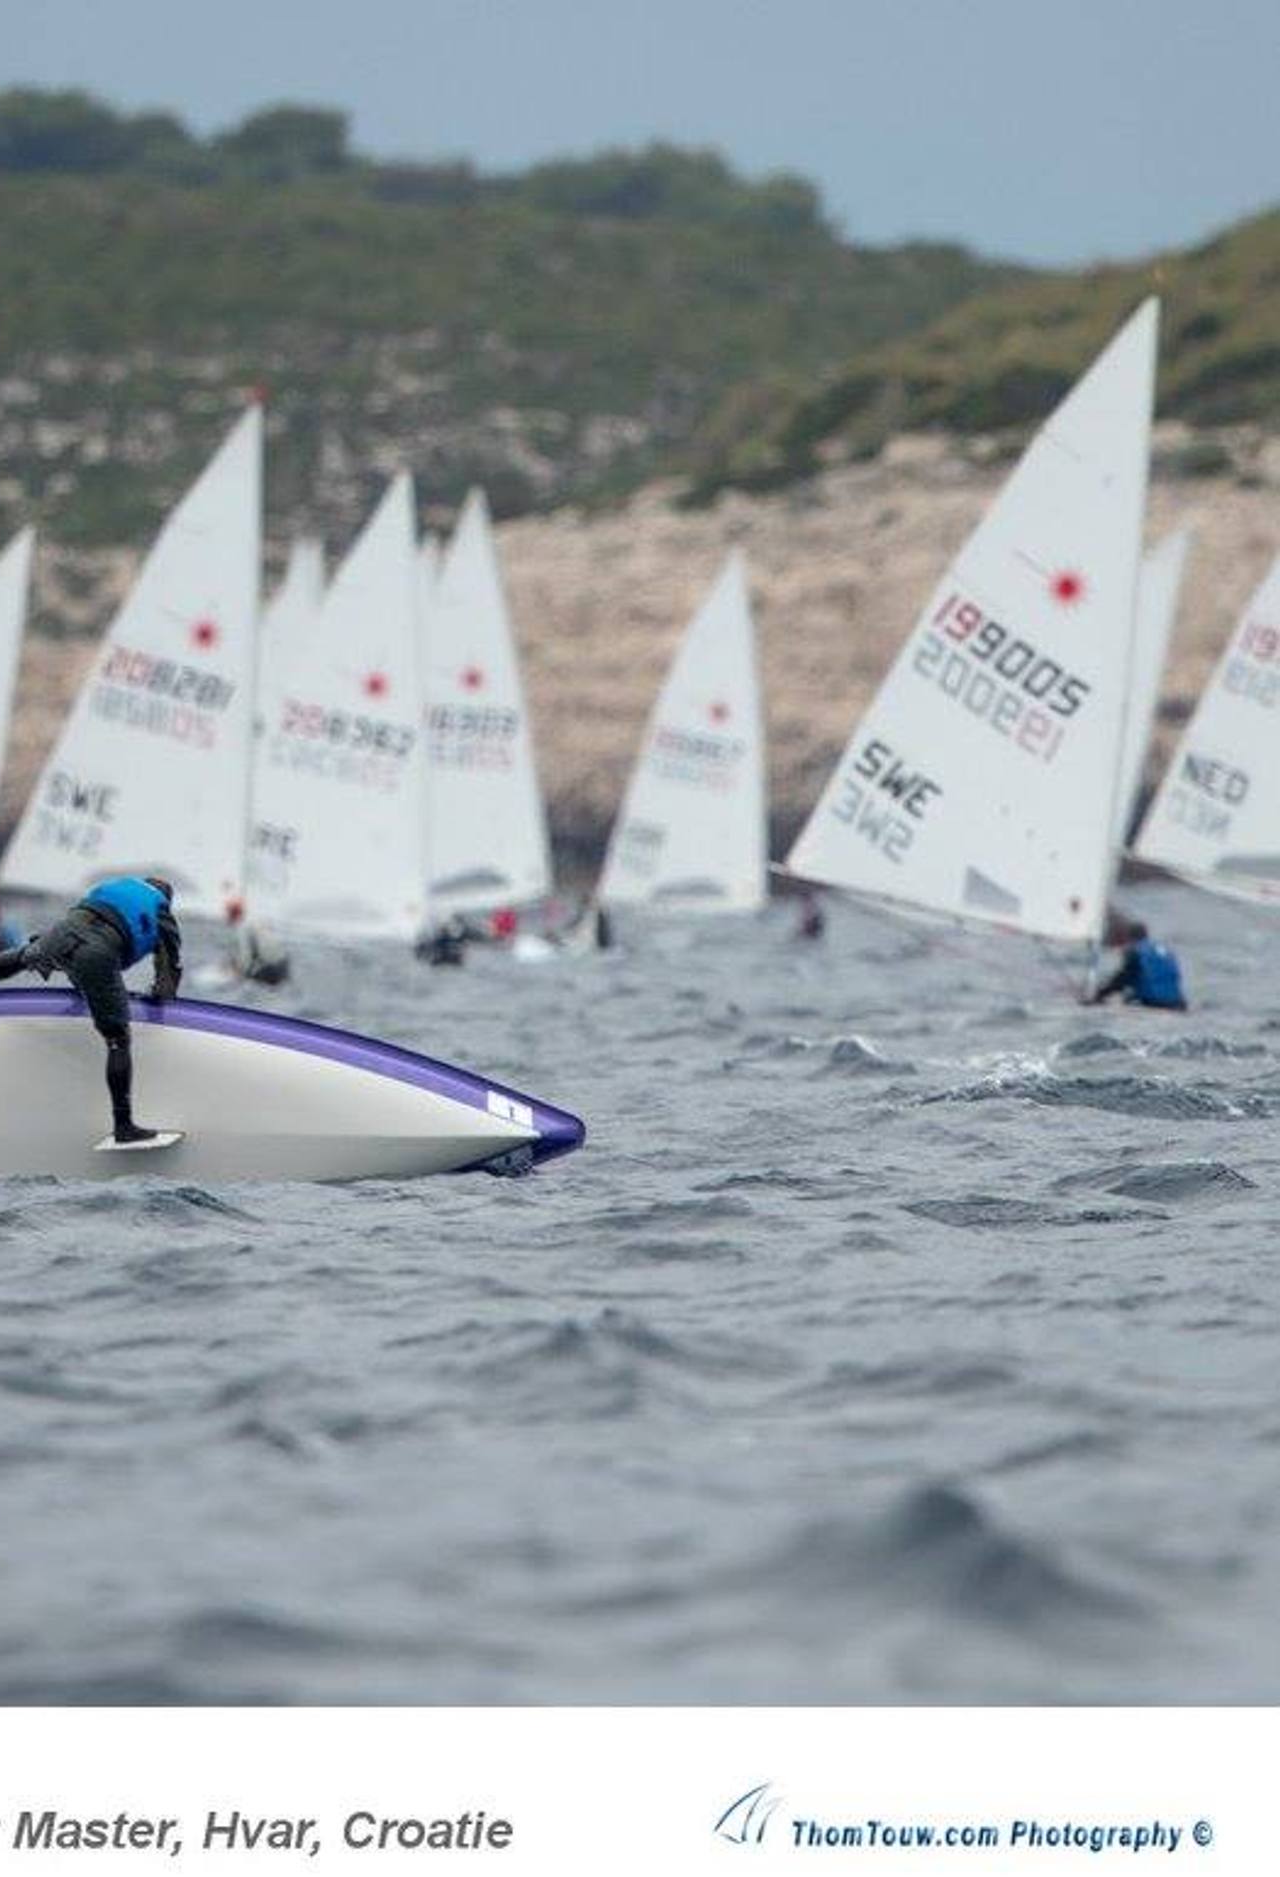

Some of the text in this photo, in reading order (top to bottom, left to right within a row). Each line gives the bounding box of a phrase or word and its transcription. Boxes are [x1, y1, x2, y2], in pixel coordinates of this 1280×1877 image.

[931, 595, 1092, 719] 199005
[46, 772, 121, 822] SWE
[854, 740, 943, 820] SWE
[1181, 751, 1250, 807] NED
